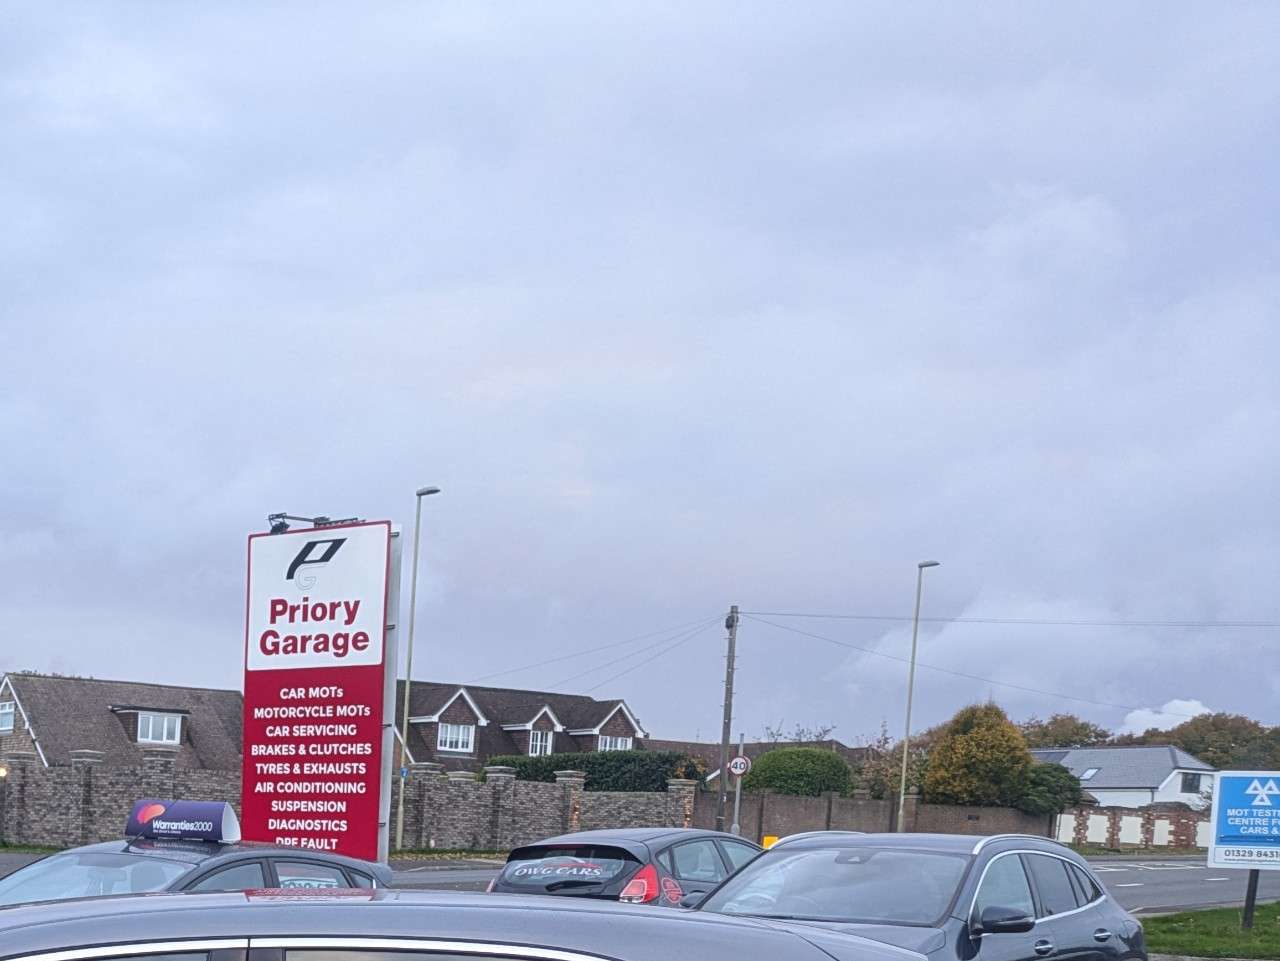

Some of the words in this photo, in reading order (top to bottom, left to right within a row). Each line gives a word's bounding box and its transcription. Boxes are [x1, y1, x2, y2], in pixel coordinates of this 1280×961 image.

[270, 597, 361, 625] Priory
[259, 630, 370, 658] Garage
[280, 688, 305, 699] CAR
[308, 686, 344, 698] MOTs
[254, 706, 333, 719] MOTORCYCLE
[336, 705, 371, 717] MOTs
[266, 726, 290, 737] CAR
[292, 724, 357, 737] SERVICING
[251, 744, 296, 756] BRAKES
[298, 745, 306, 755] &
[308, 743, 372, 756] CLUTCHES
[255, 763, 291, 774] TYRES
[293, 763, 301, 774] &
[303, 762, 367, 775] EXHAUSTS
[732, 762, 746, 770] 40
[254, 782, 274, 793] AIR
[276, 781, 367, 794] CONDITIONING
[271, 800, 347, 813] SUSPENSION
[152, 819, 213, 832] Warranties2000
[268, 819, 348, 832] DIAGNOSTICS
[300, 837, 339, 850] FAULT
[556, 866, 602, 876] CARS
